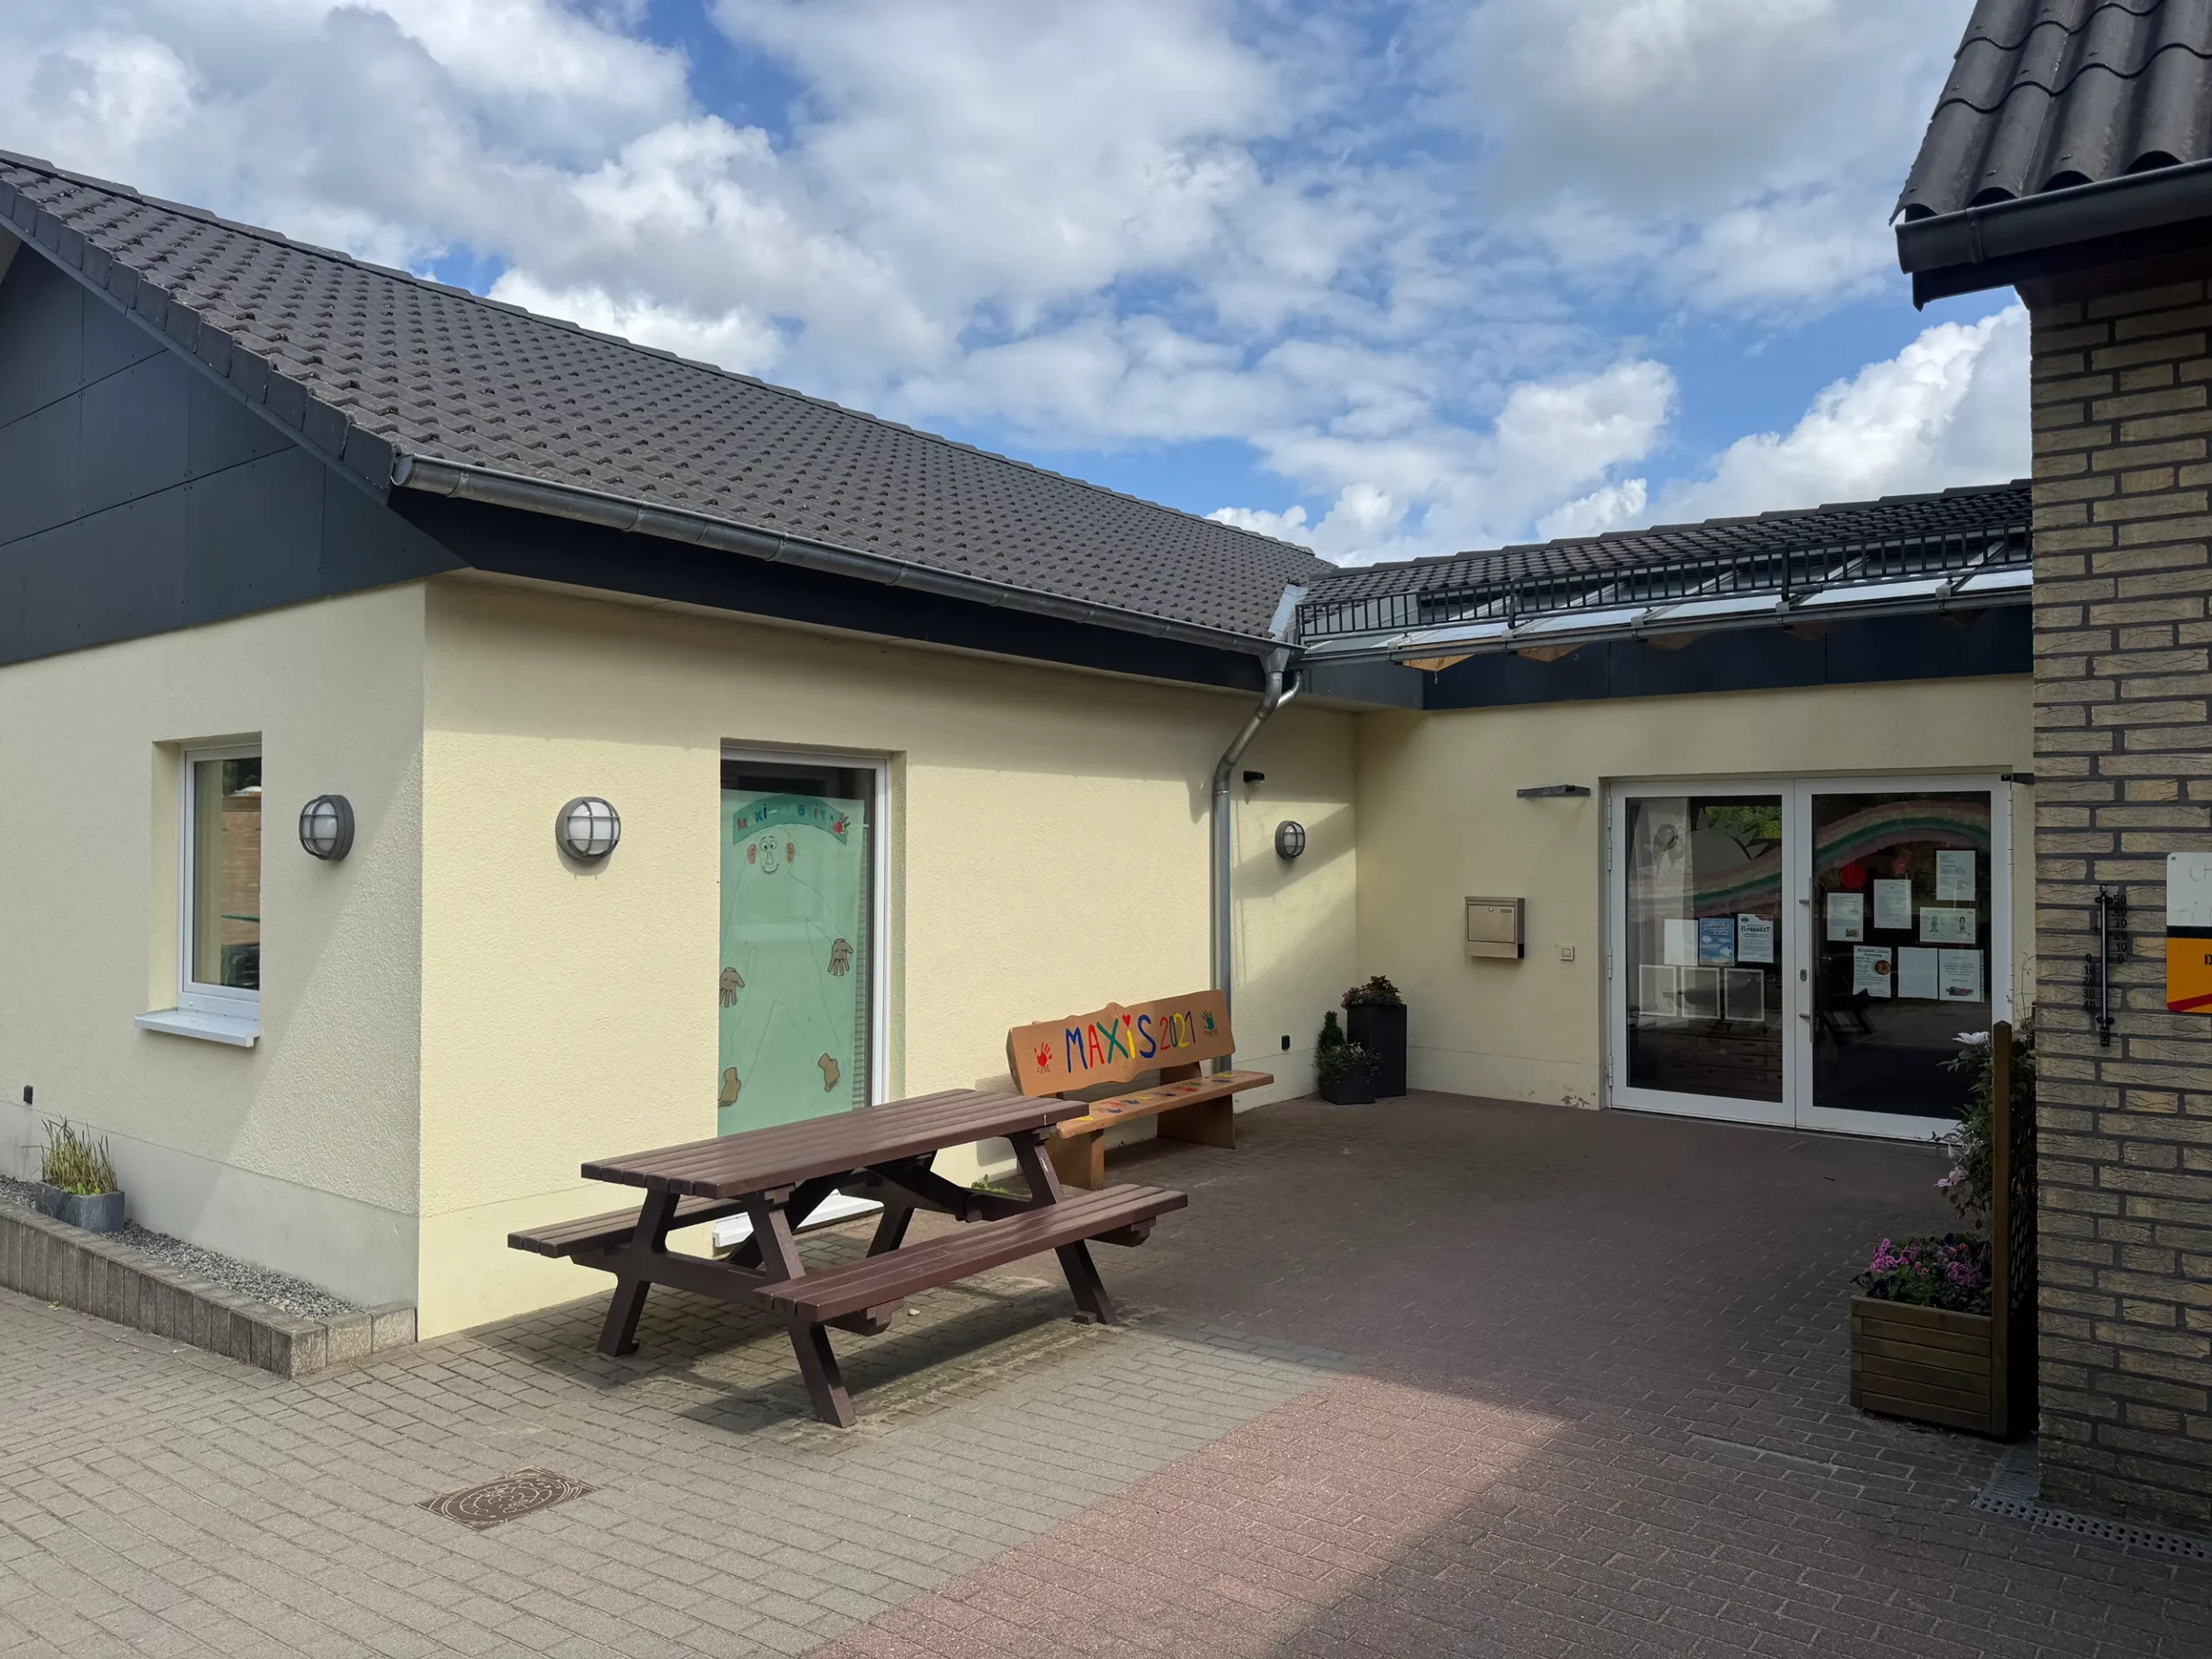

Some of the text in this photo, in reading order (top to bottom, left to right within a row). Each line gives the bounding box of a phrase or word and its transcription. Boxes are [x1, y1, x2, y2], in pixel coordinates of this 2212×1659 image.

[2113, 894, 2126, 905] 50
[2113, 907, 2126, 916] 40
[2113, 918, 2126, 928] 30
[2113, 931, 2126, 940] 20
[2116, 942, 2126, 951] 10
[2085, 953, 2092, 963] 0
[2082, 988, 2095, 998] 30
[2083, 1001, 2095, 1009] 40
[1160, 1011, 1196, 1051] 2021
